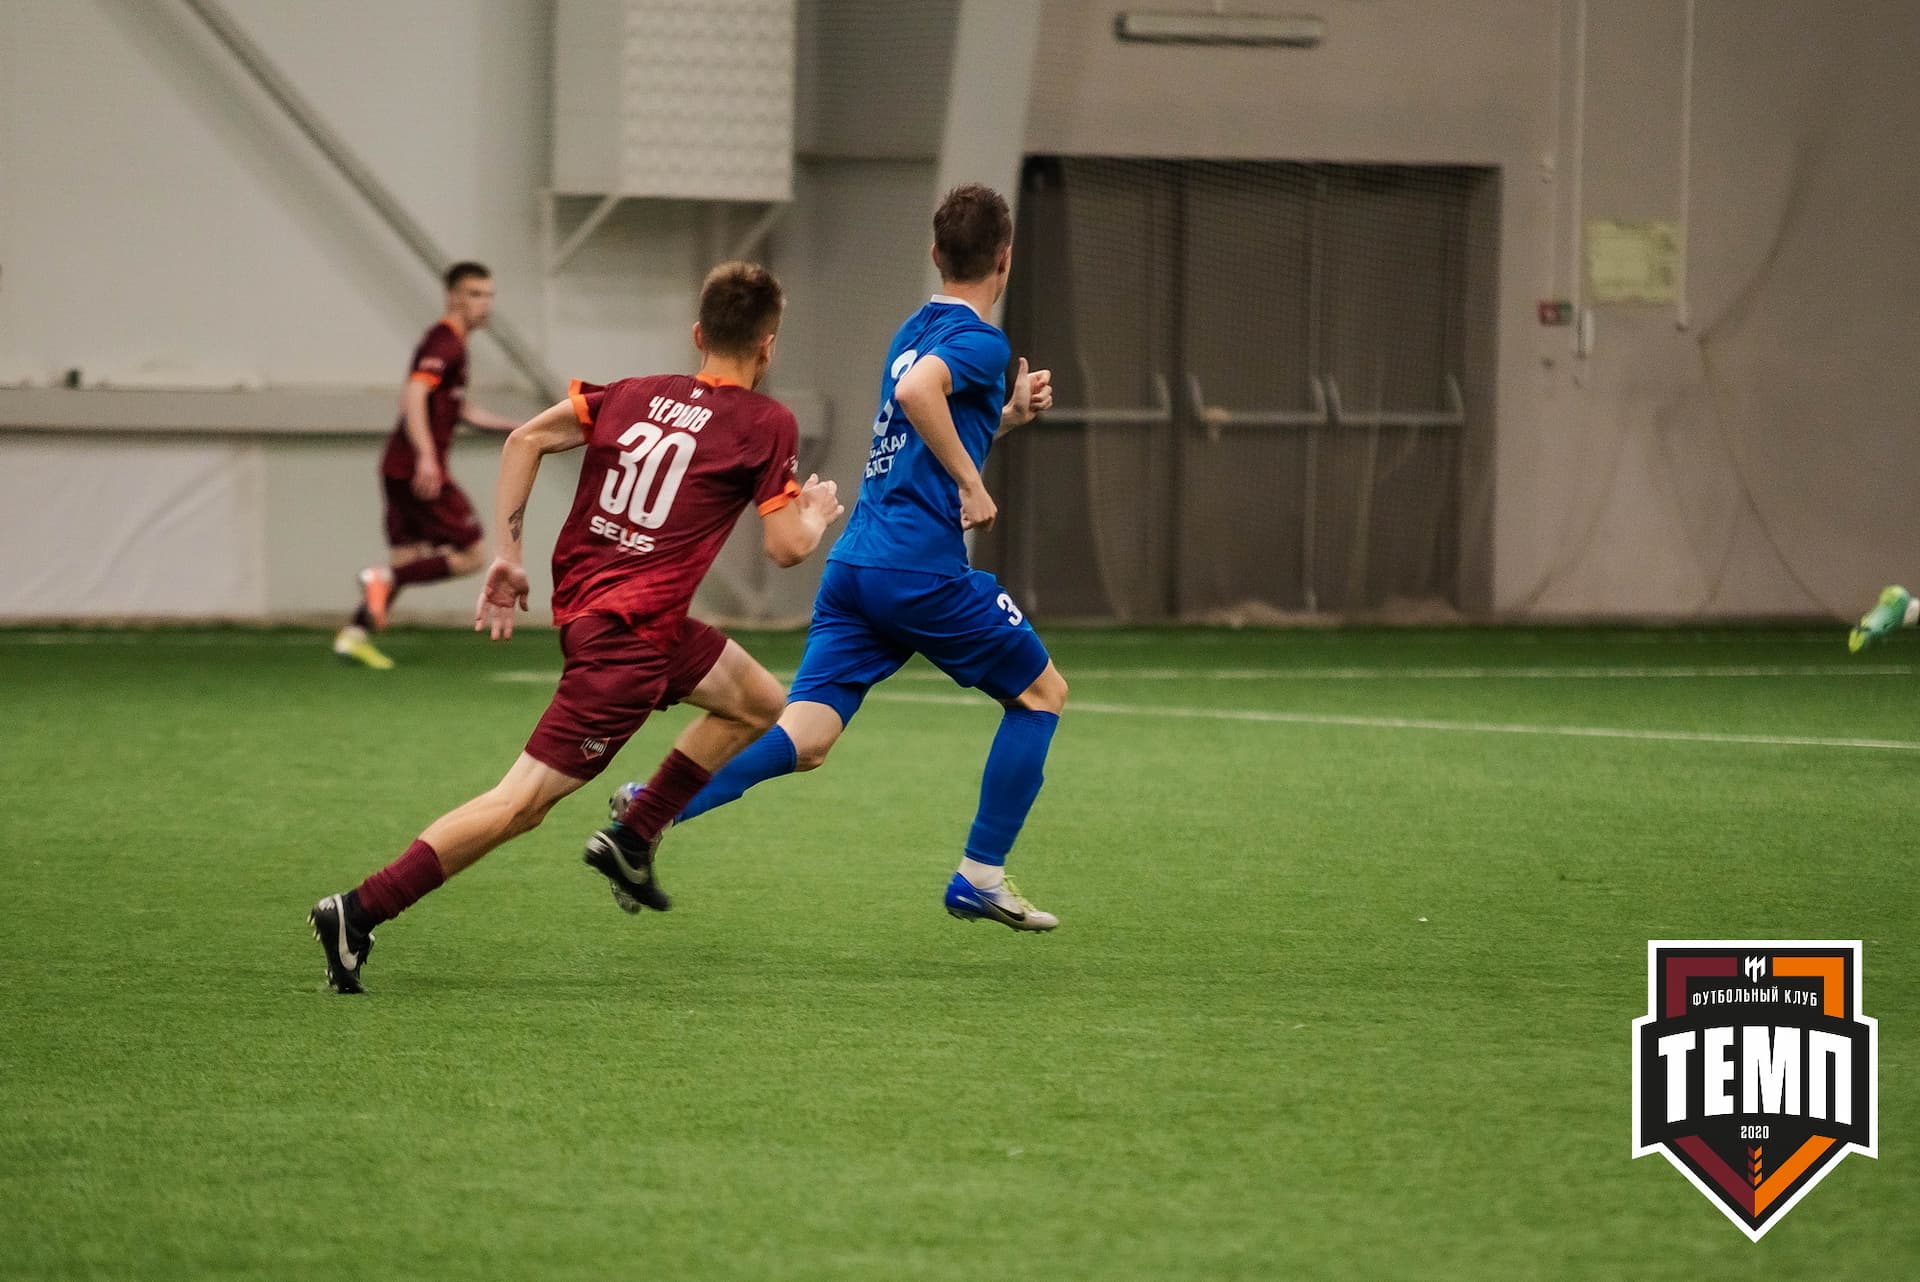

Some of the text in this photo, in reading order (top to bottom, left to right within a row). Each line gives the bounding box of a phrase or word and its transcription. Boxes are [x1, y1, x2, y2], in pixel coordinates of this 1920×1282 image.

[600, 421, 697, 529] 30
[589, 515, 656, 553] SEUS
[996, 592, 1023, 626] 3
